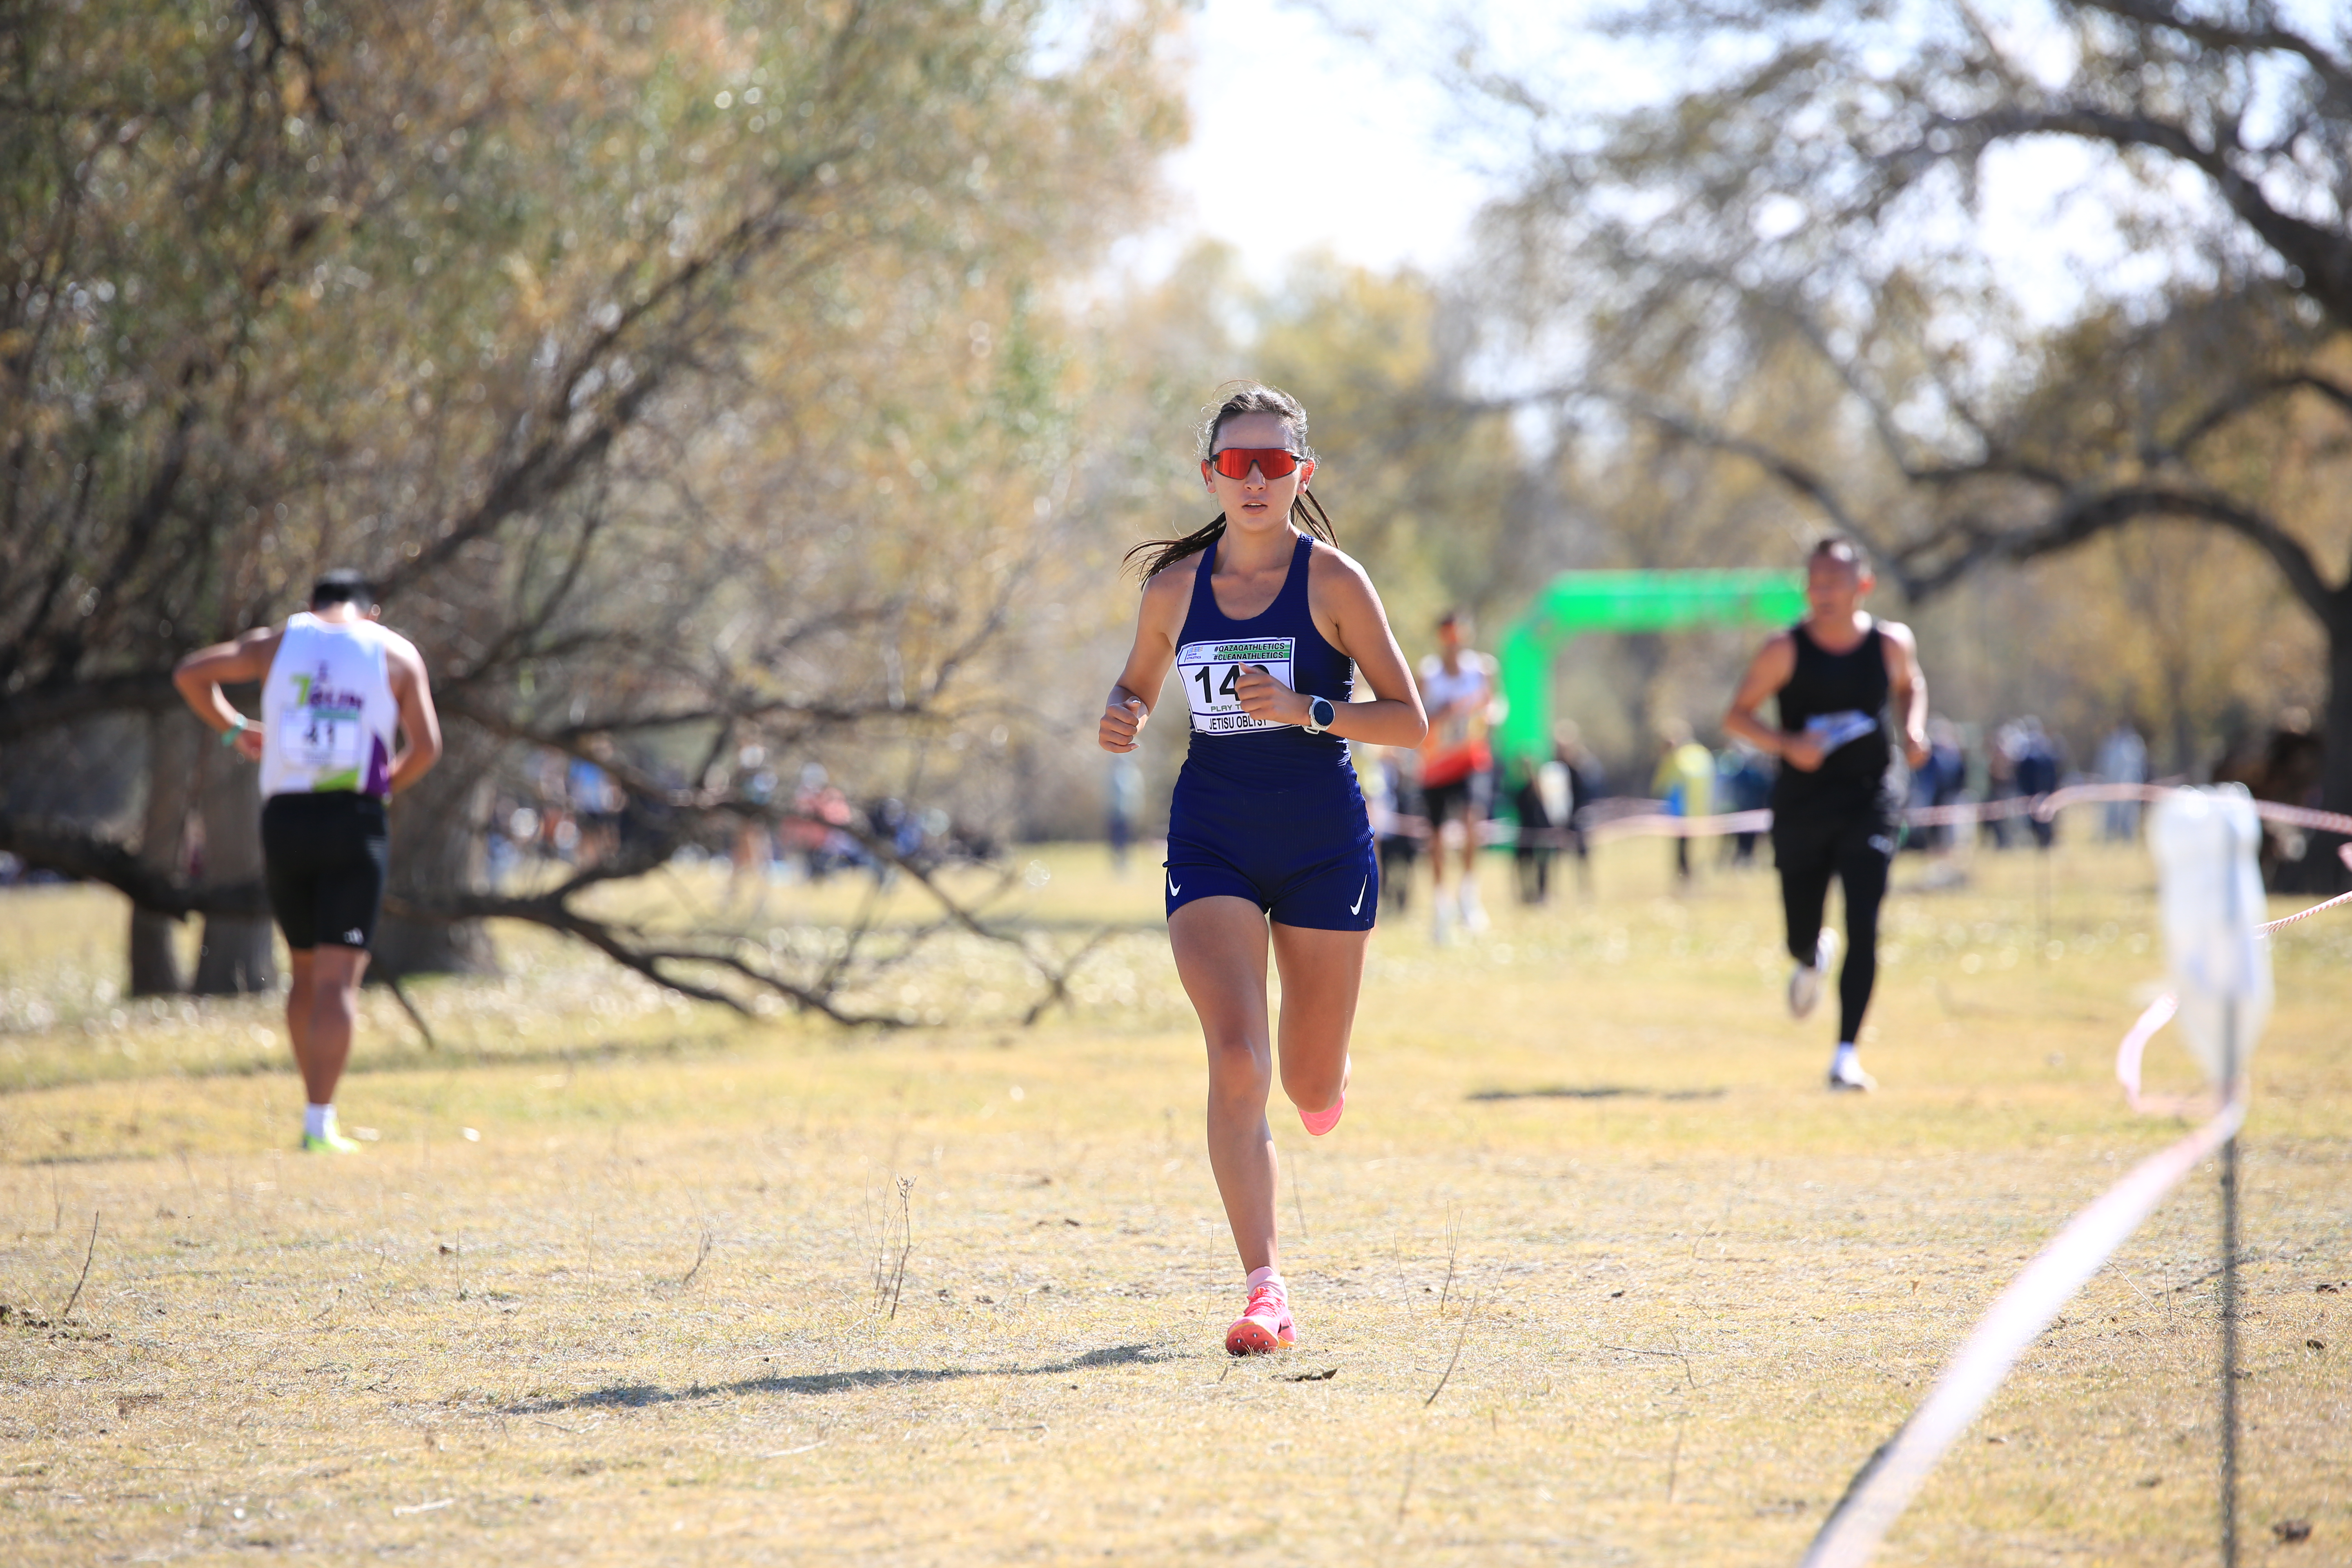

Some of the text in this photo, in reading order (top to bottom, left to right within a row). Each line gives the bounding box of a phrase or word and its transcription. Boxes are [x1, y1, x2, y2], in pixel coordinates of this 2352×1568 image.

[1214, 643, 1285, 652] #QAZAQATHLETICS
[1214, 652, 1283, 661] #CLEANATHLETICS
[1195, 664, 1270, 703] 14
[1209, 716, 1234, 730] JETISU
